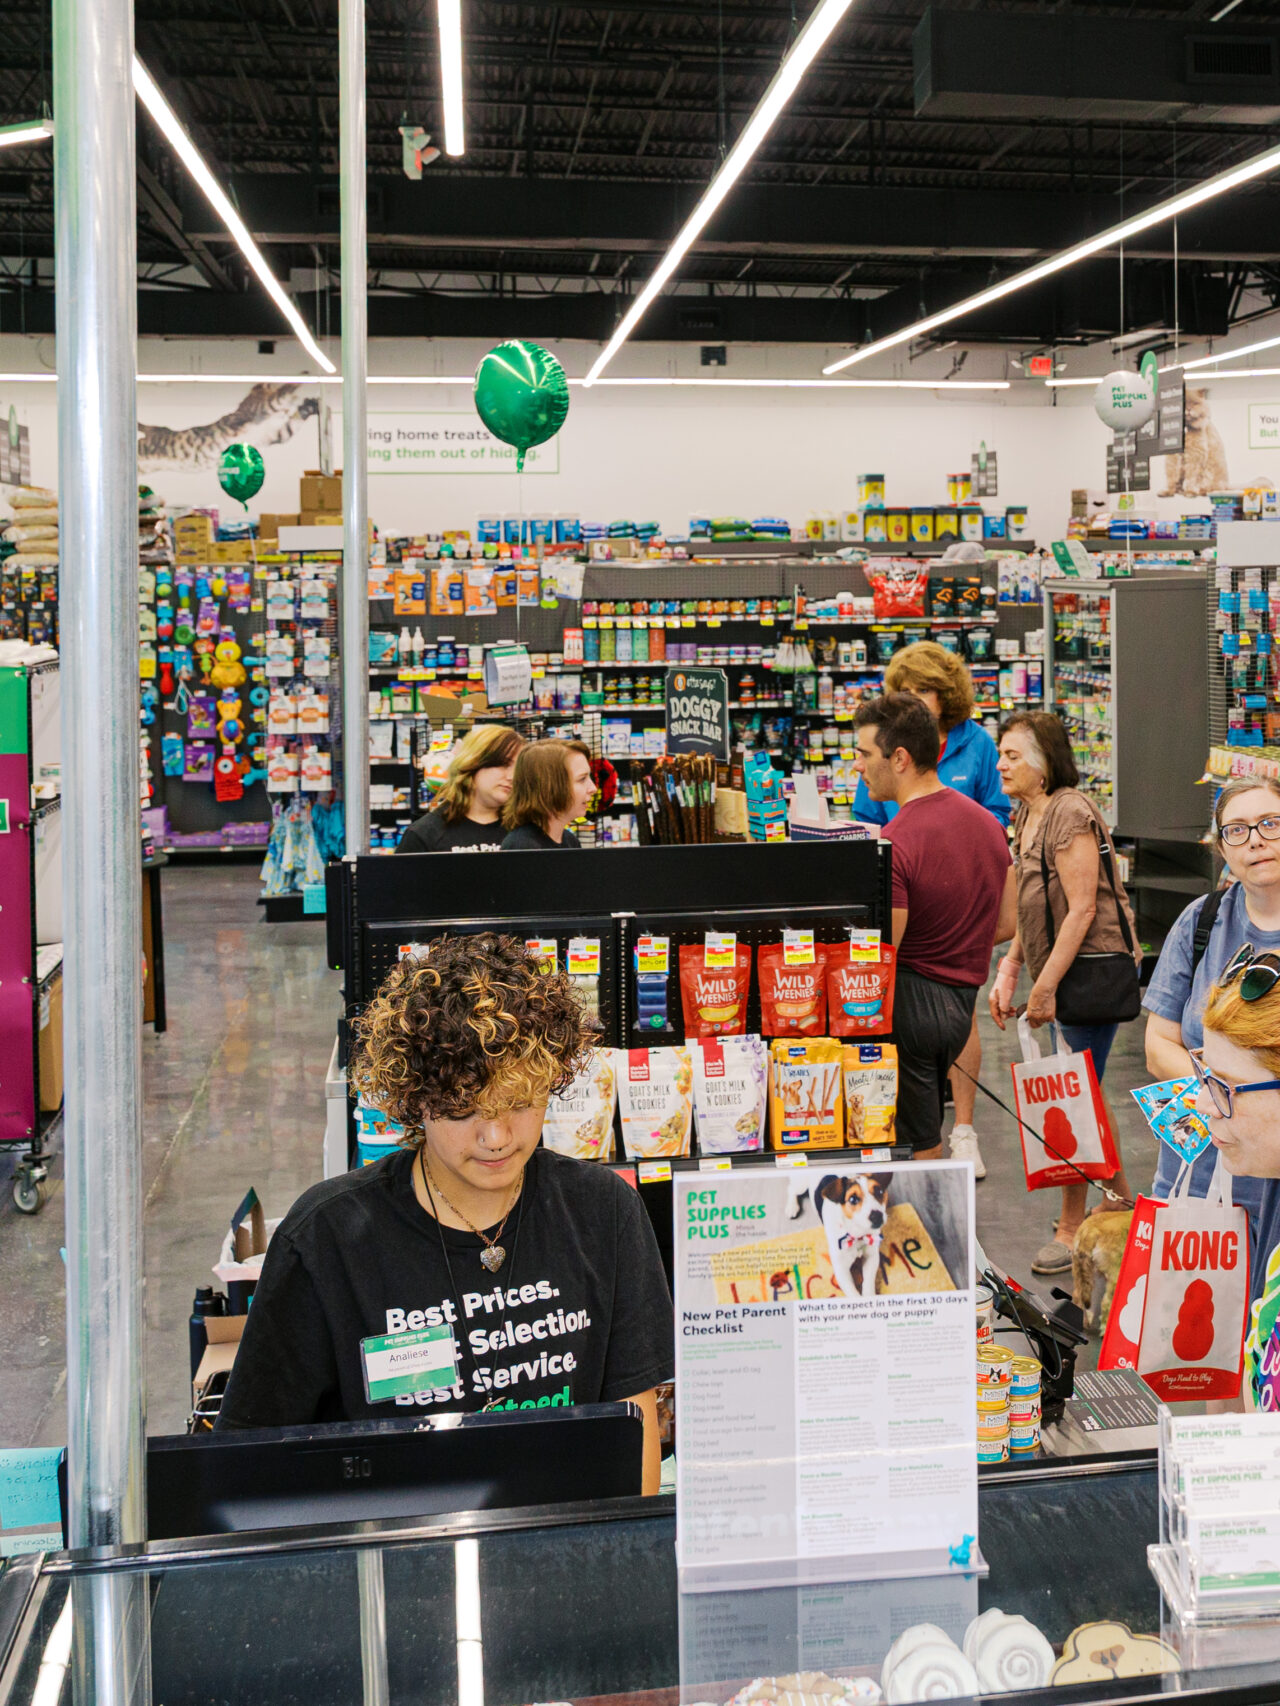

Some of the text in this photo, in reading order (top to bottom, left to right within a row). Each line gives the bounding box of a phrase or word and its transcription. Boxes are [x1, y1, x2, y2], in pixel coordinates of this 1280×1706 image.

[397, 428, 490, 441] home treats
[396, 446, 485, 459] them out of
[670, 695, 722, 723] DOGGY
[670, 719, 722, 742] SNACK BAR
[697, 974, 737, 993] WILD
[775, 969, 814, 989] WILD
[841, 970, 881, 989] WILD
[695, 991, 737, 1005] WEENIES
[773, 988, 815, 1000] WEENIES
[840, 987, 881, 1000] WEENIES
[653, 1084, 671, 1096] MILK
[729, 1080, 746, 1092] MILK
[1023, 1070, 1081, 1104] KONG
[637, 1098, 666, 1110] COOKIES
[714, 1094, 742, 1106] COOKIES
[687, 1190, 717, 1206] PET
[688, 1204, 767, 1222] SUPPLIES
[688, 1224, 729, 1240] PLUS
[1160, 1231, 1239, 1271] KONG
[386, 1280, 560, 1334] Best Prices.
[799, 1304, 825, 1313] What
[827, 1303, 838, 1311] to
[841, 1301, 873, 1311] expect
[876, 1300, 885, 1308] in
[888, 1299, 904, 1307] the
[907, 1297, 927, 1306] first
[945, 1295, 969, 1305] days
[683, 1306, 787, 1322] New Pet Parent
[799, 1314, 821, 1323] with
[823, 1314, 845, 1323] your
[870, 1311, 889, 1320] dog
[468, 1308, 591, 1355] Selection.
[683, 1323, 744, 1336] Checklist
[389, 1348, 429, 1363] Analiese
[472, 1351, 577, 1393] Service.
[1177, 1373, 1192, 1381] Need
